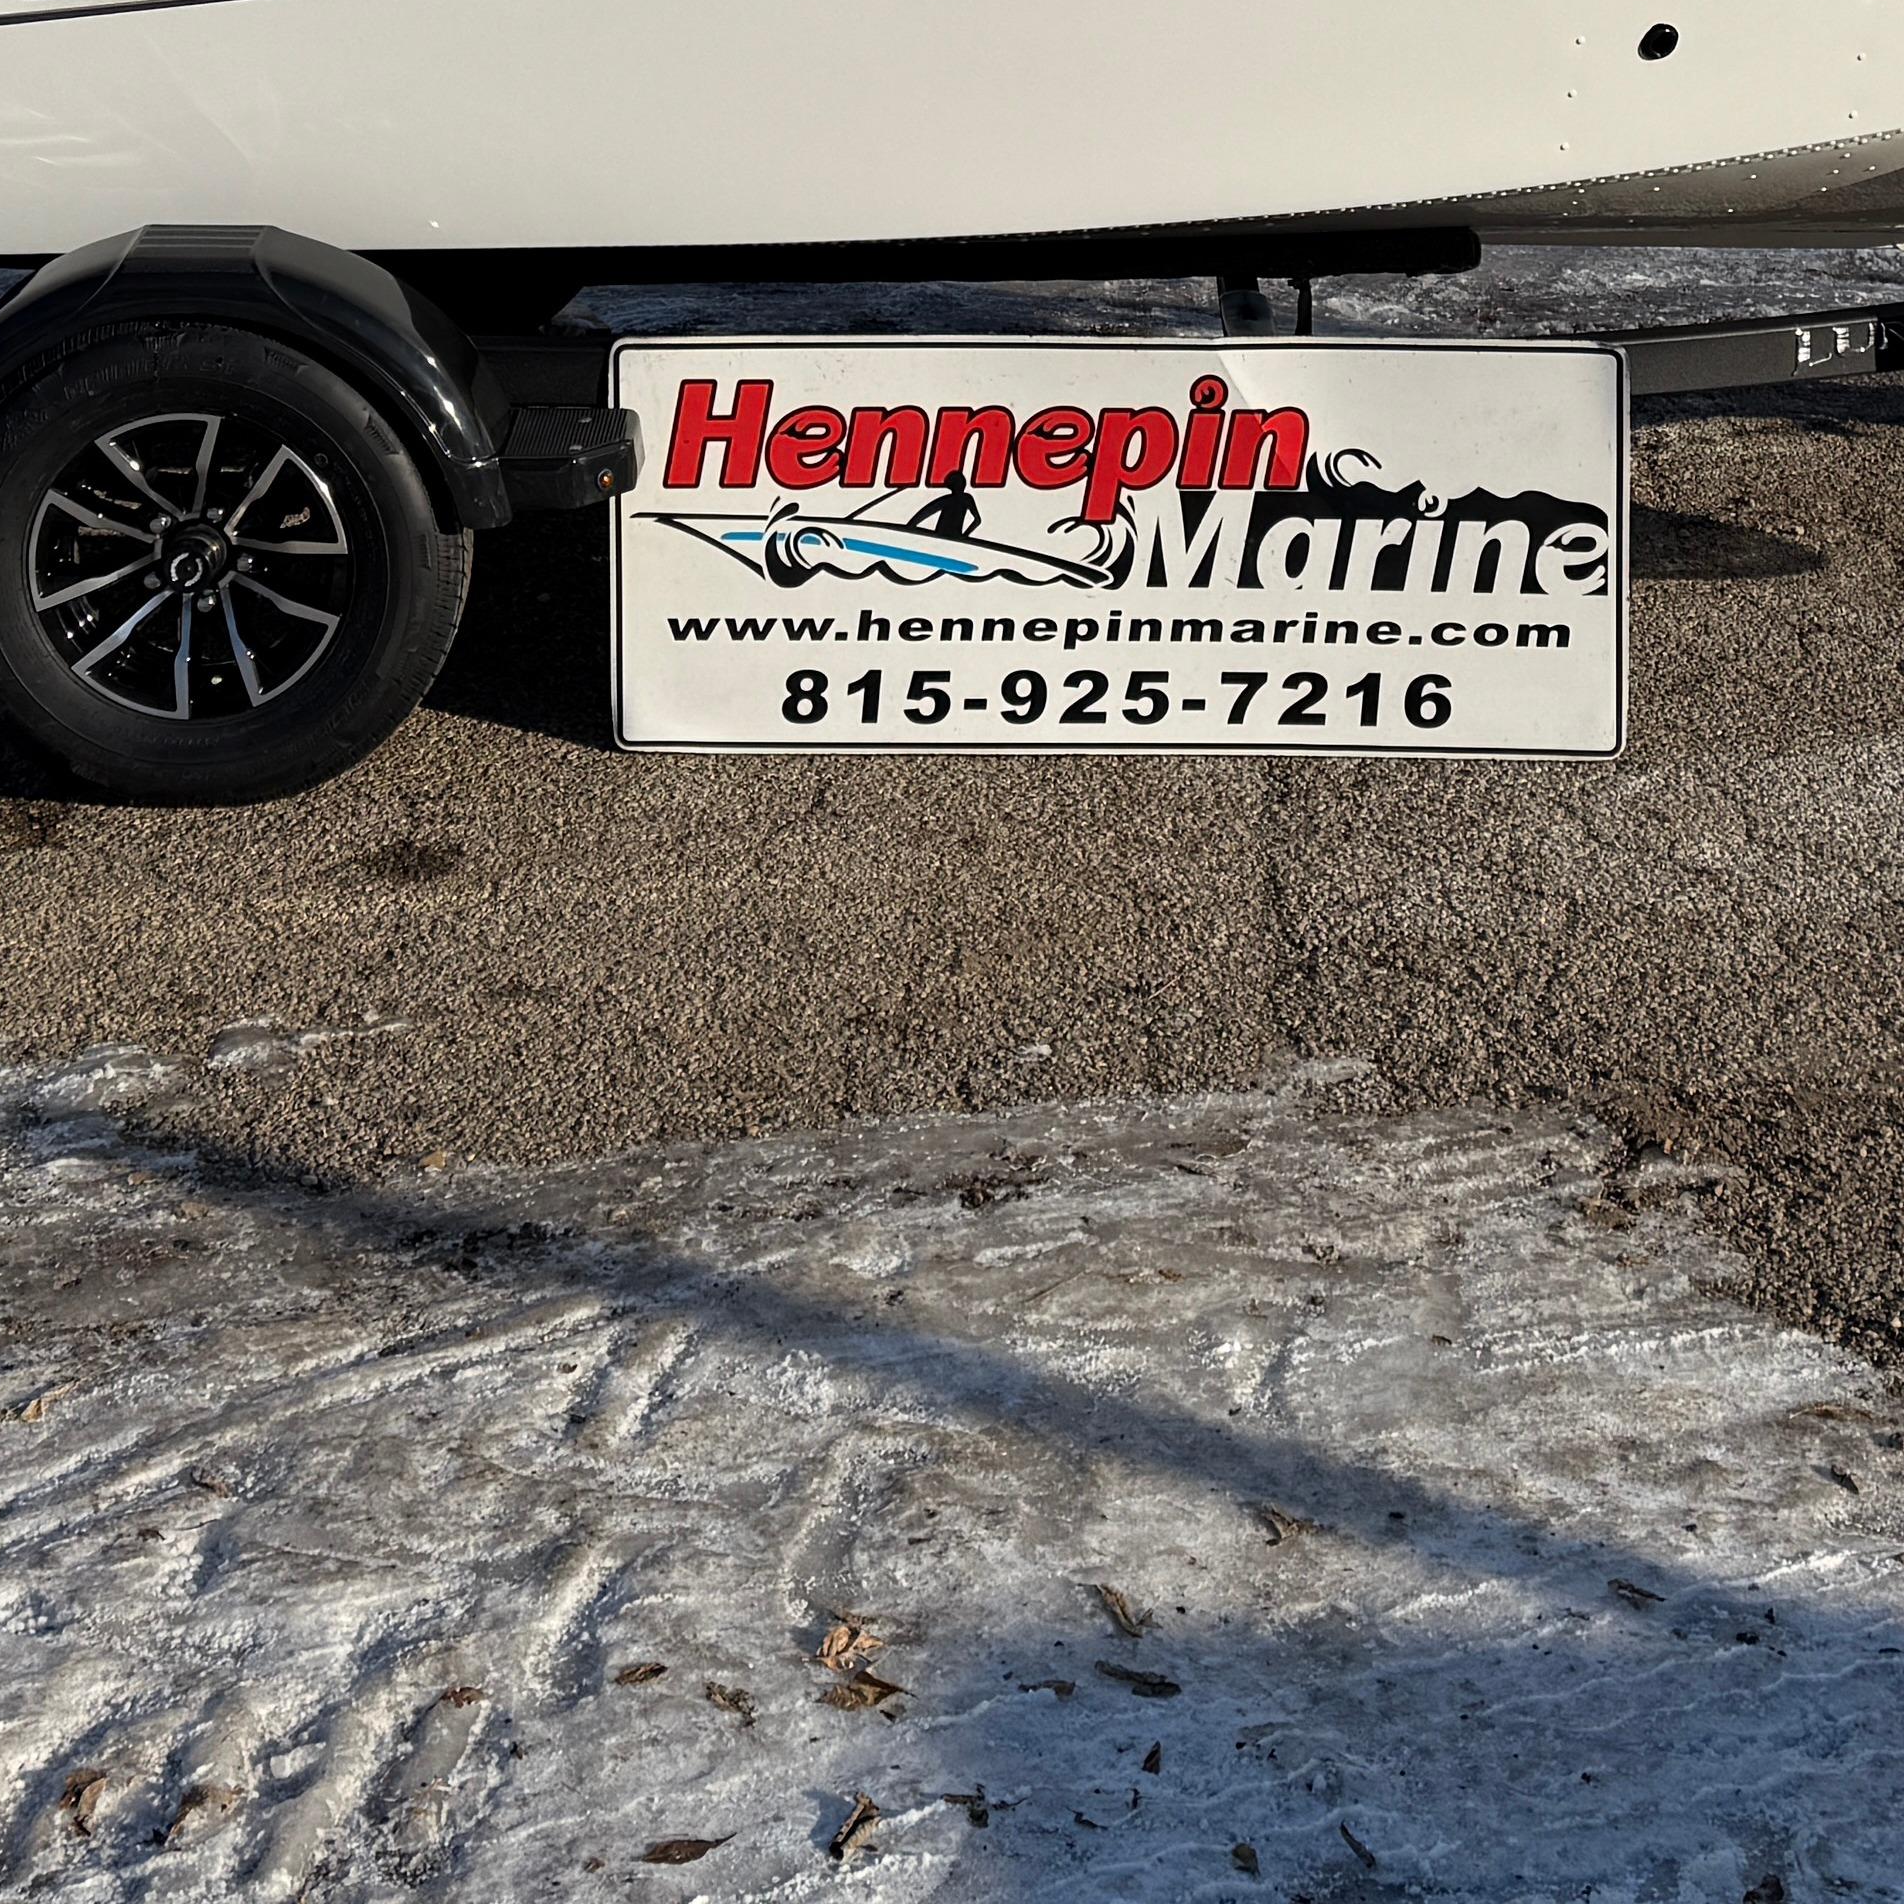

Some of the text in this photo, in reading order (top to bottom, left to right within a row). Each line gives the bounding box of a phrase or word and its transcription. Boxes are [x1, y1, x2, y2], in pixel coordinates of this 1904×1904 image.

[662, 374, 1311, 523] Hennepin
[1128, 486, 1610, 598] Marine
[667, 608, 1572, 651] www.hennepinmarine.com
[780, 668, 1454, 730] 815-925-7216
